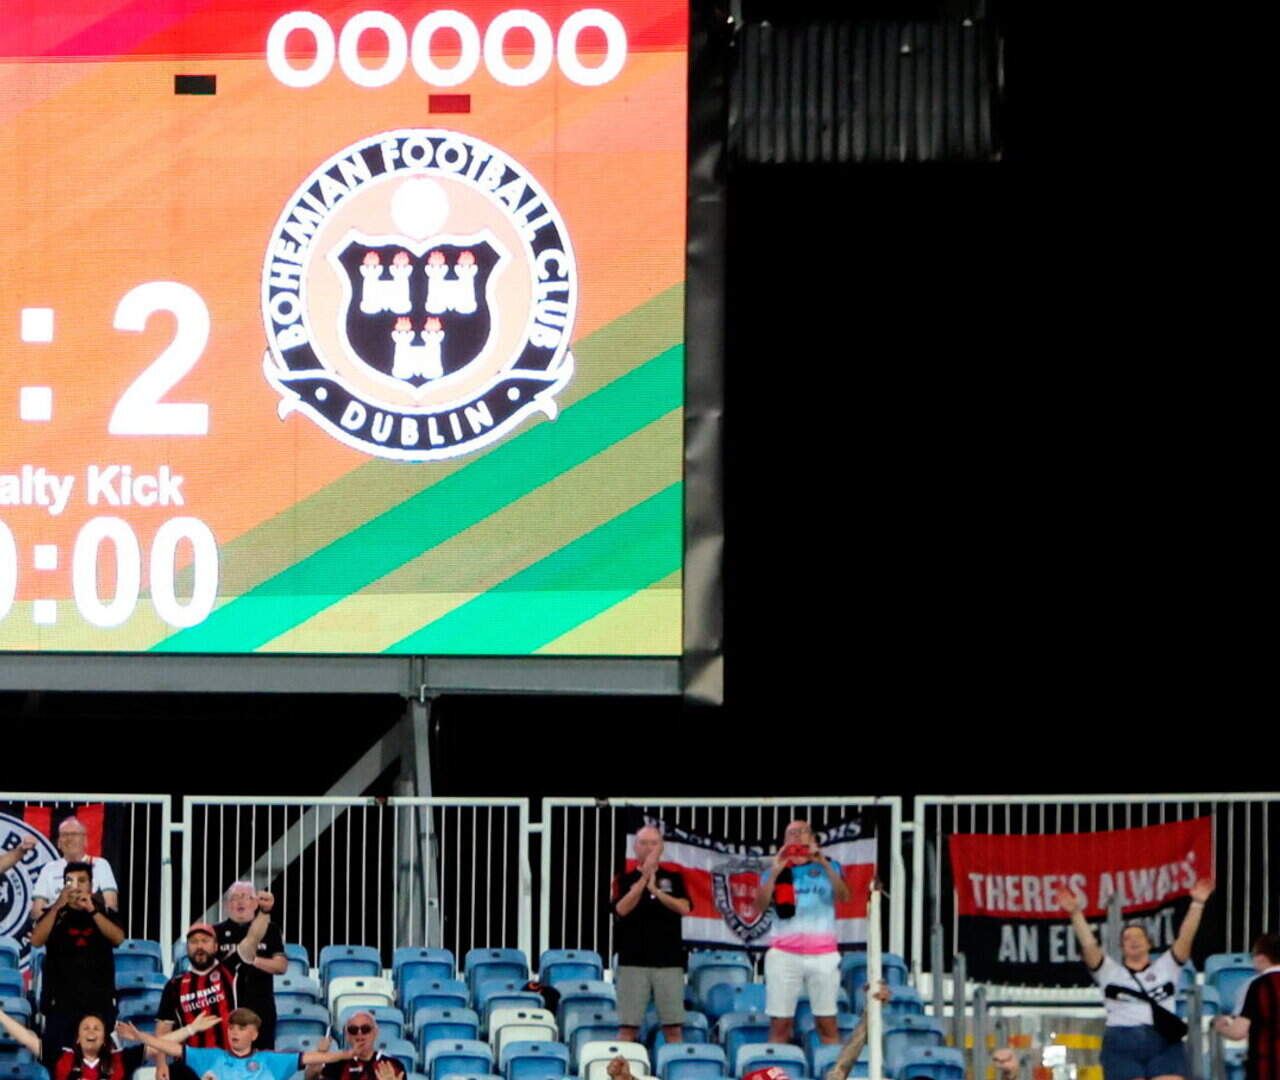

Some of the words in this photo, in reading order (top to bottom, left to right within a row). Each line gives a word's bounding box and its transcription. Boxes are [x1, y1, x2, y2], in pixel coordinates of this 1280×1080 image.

[269, 155, 371, 351] BOHEMIAN
[380, 136, 554, 243] FOOTBALL
[529, 248, 571, 350] CLUB
[108, 280, 211, 435] 2
[341, 398, 495, 447] DUBLIN
[87, 464, 185, 506] Kick
[968, 872, 1088, 913] THERE'S
[1098, 851, 1199, 909] ALWAYS
[998, 925, 1039, 963] AN
